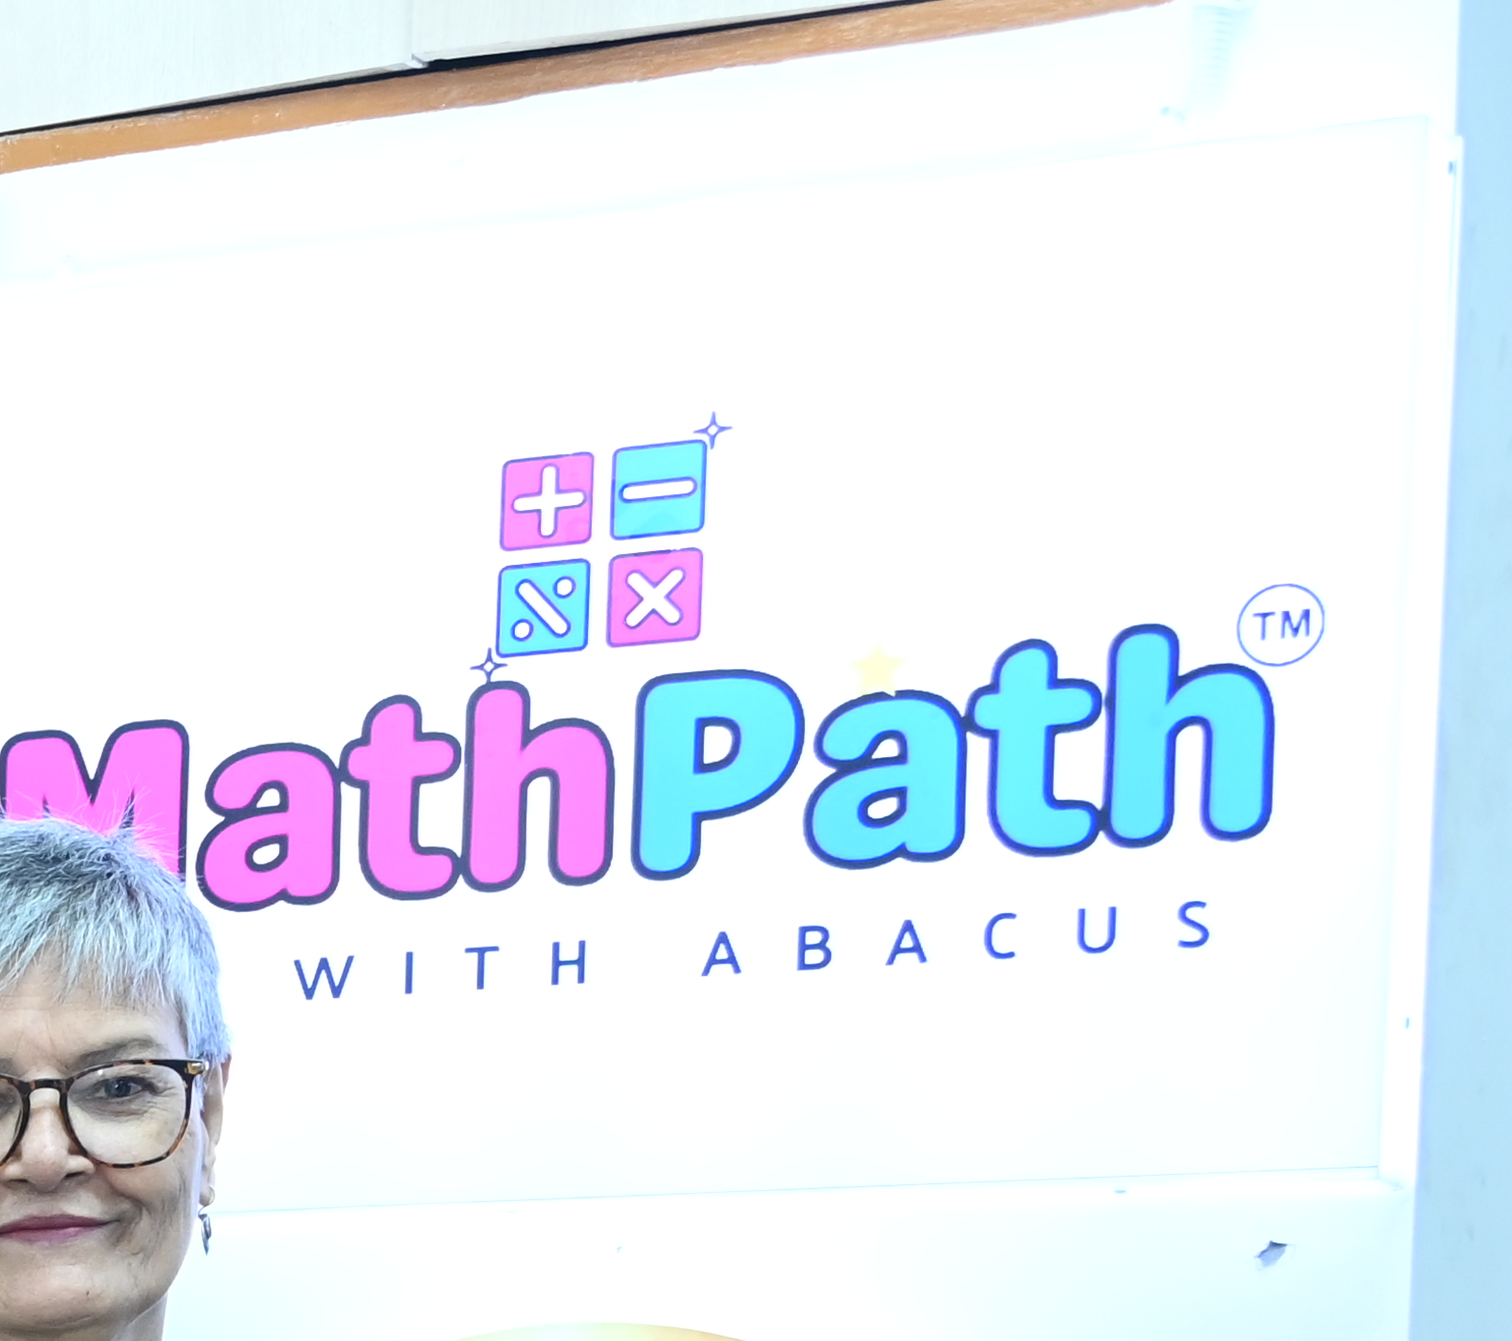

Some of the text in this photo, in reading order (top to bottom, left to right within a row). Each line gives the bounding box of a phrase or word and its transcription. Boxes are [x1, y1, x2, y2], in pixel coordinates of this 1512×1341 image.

[1252, 608, 1311, 641] TM
[293, 900, 1211, 1001] WITH ABACUS
